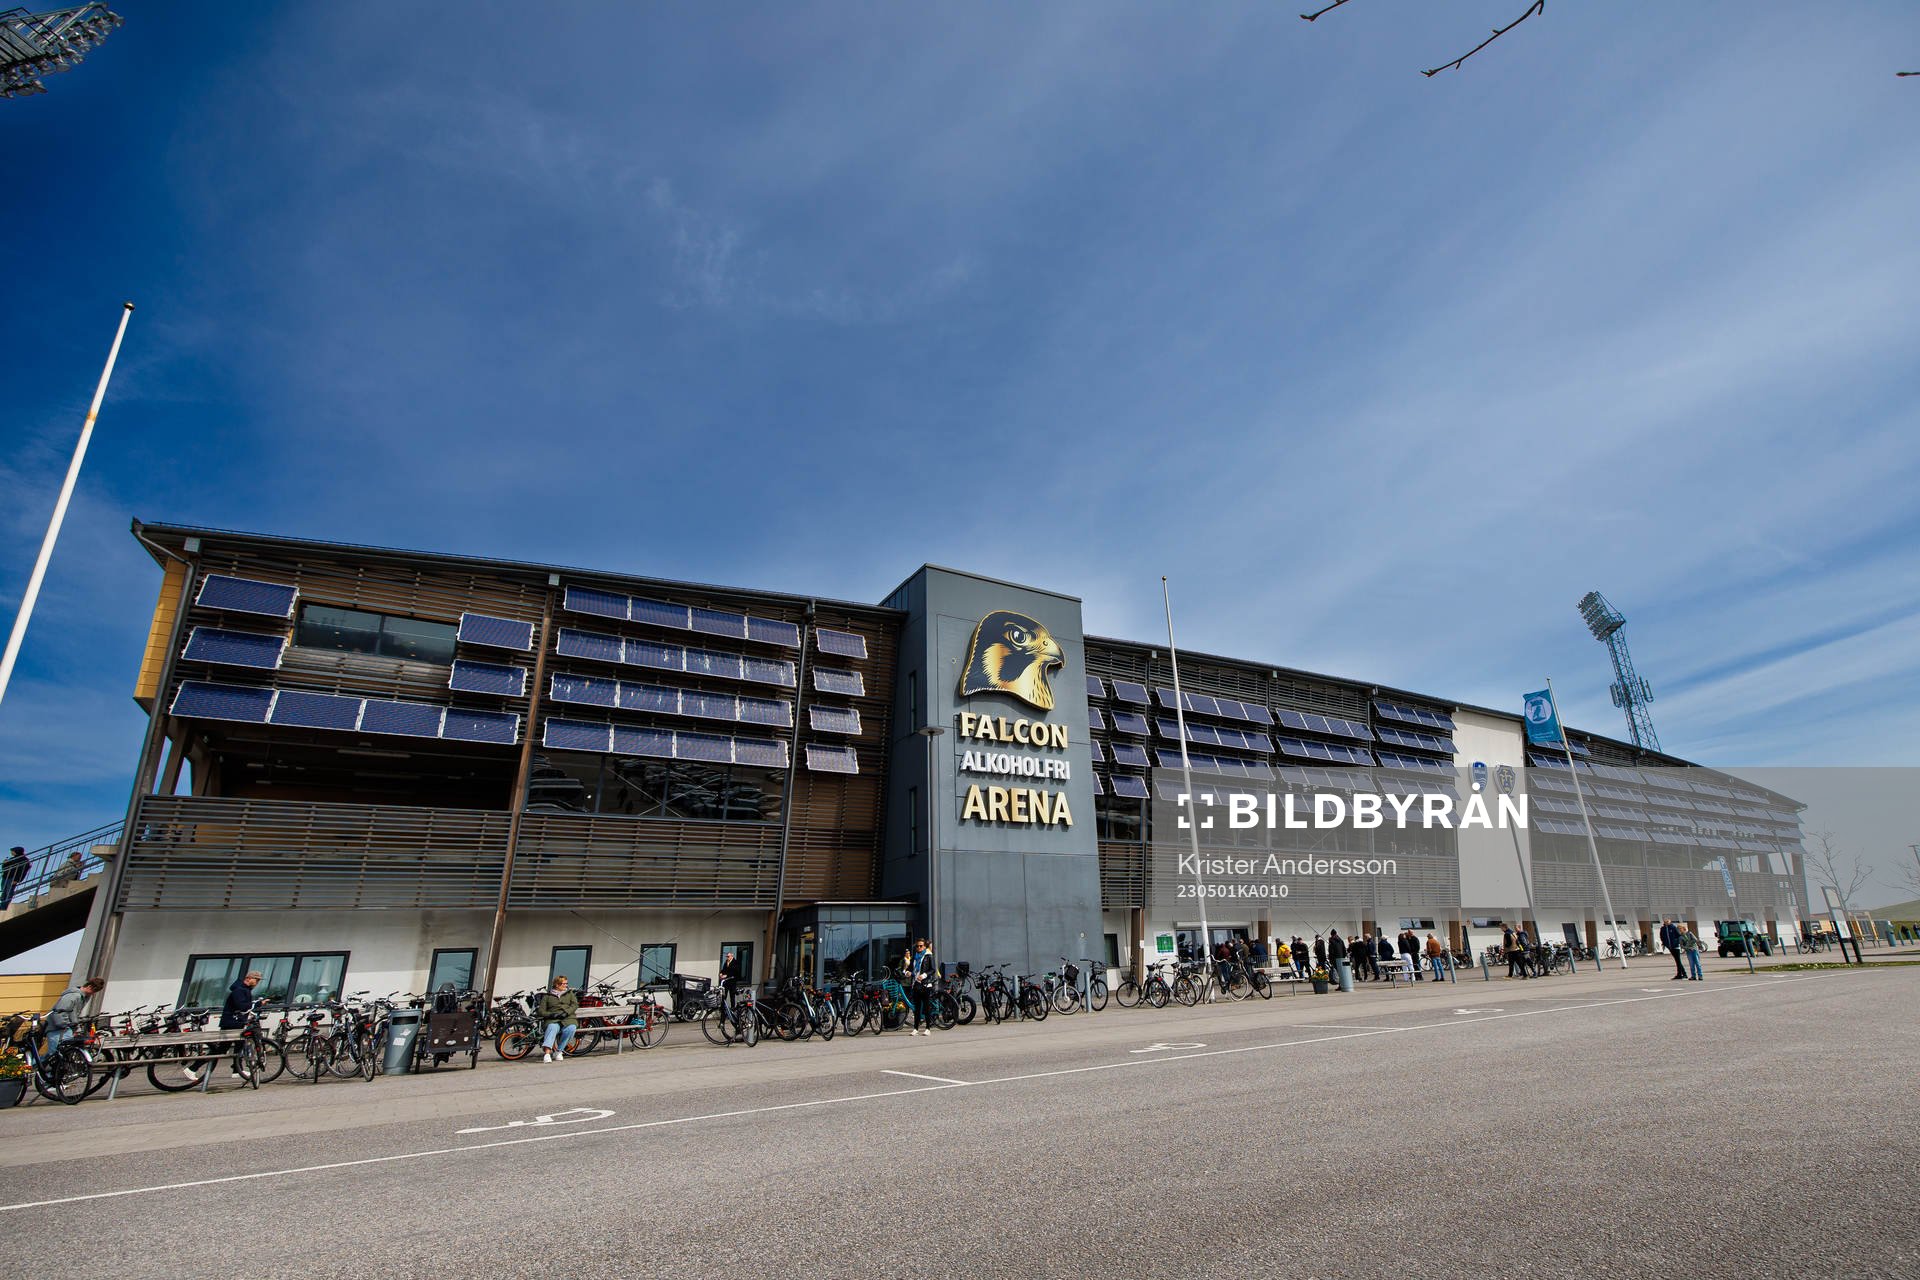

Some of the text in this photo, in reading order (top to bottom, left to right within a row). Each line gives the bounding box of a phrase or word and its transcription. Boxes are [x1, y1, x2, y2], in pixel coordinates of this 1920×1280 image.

[960, 712, 1068, 748] FALCON
[960, 750, 1070, 780] ALKOHOLFRI
[963, 784, 1073, 826] ARENA
